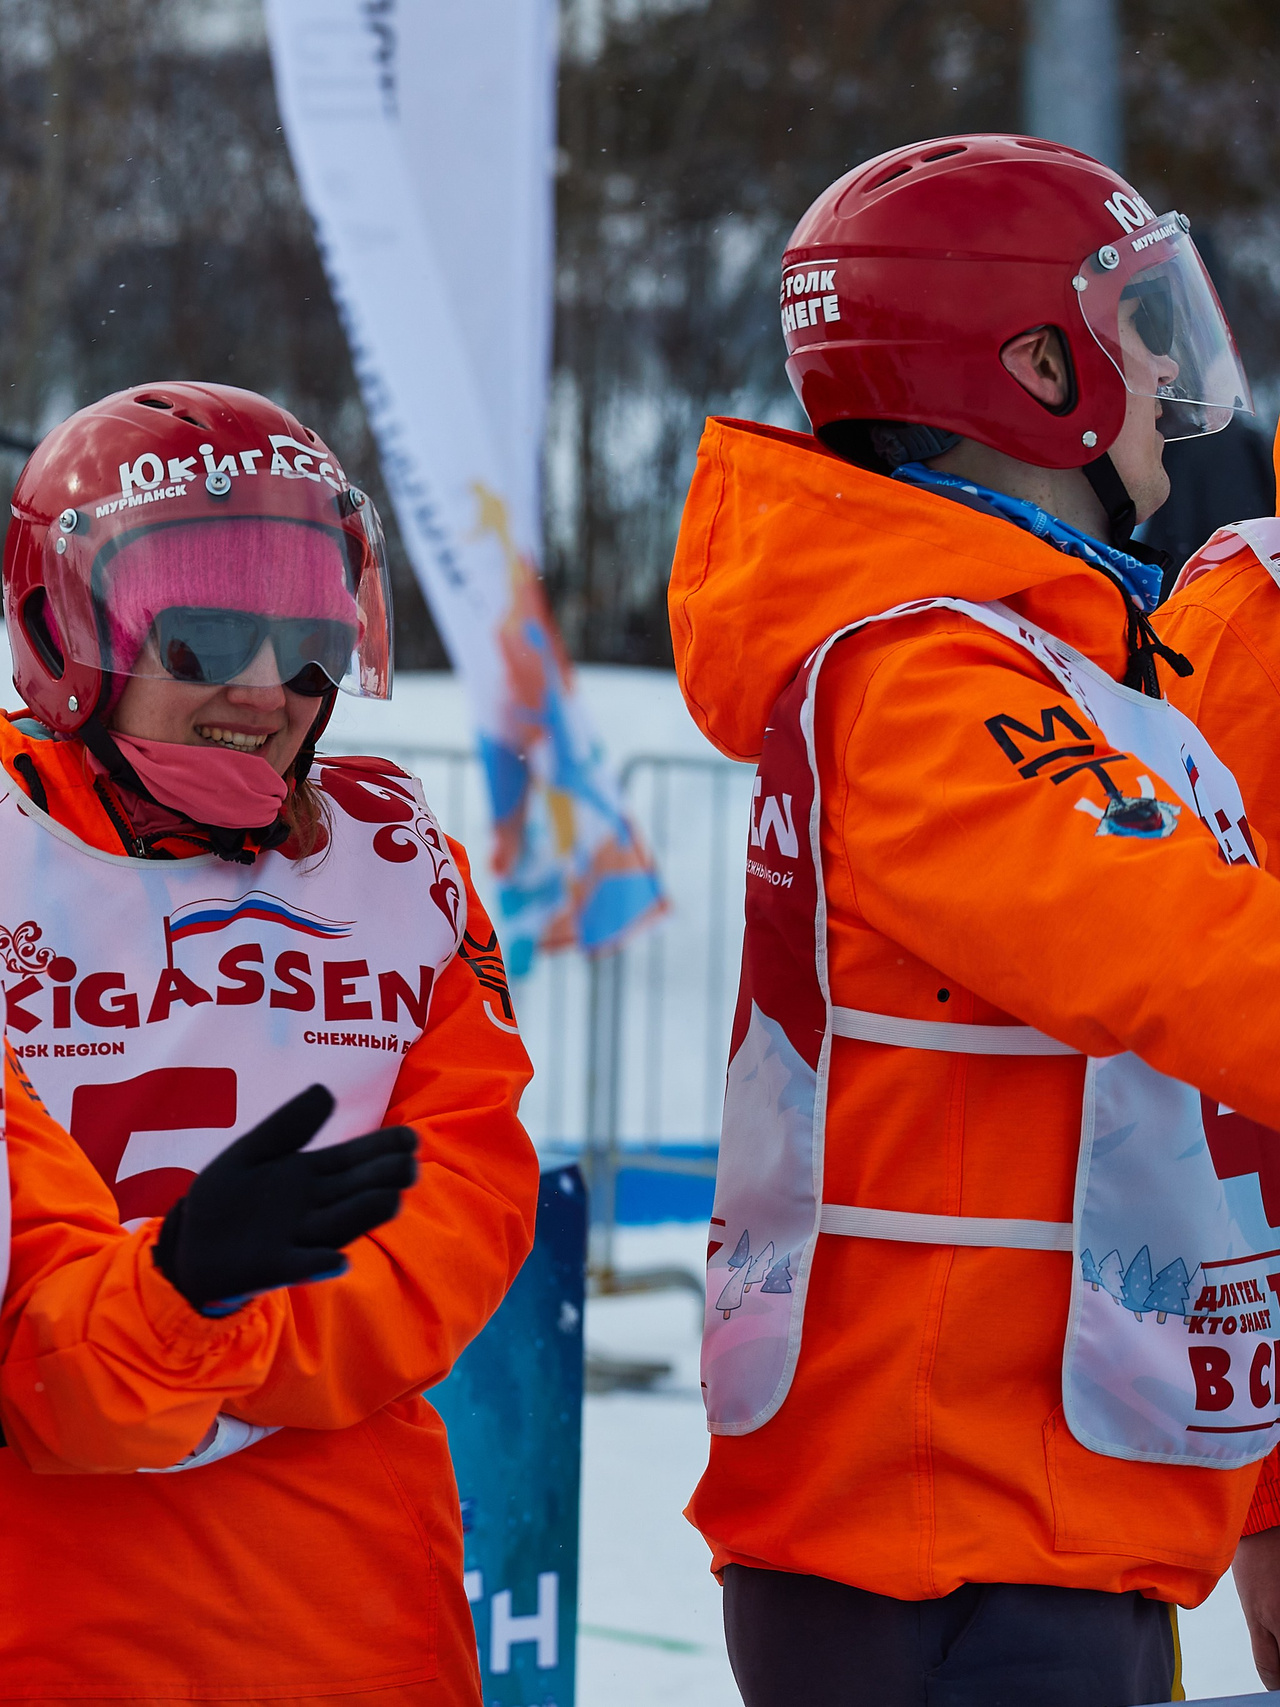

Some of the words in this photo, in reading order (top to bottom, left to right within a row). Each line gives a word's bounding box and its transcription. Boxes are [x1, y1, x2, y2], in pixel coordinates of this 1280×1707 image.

[785, 270, 836, 297] ТОЛК
[95, 484, 187, 519] МУРМАНСК
[54, 1042, 124, 1058] REGION
[303, 1030, 398, 1053] СНЕЖНЫЙ
[1194, 1283, 1237, 1312] ДЛЯ
[1236, 1279, 1266, 1304] ТЕХ,
[1188, 1316, 1237, 1335] КТО
[1239, 1309, 1272, 1333] ЗНАЕТ
[1188, 1346, 1234, 1411] В
[1250, 1341, 1280, 1408] С
